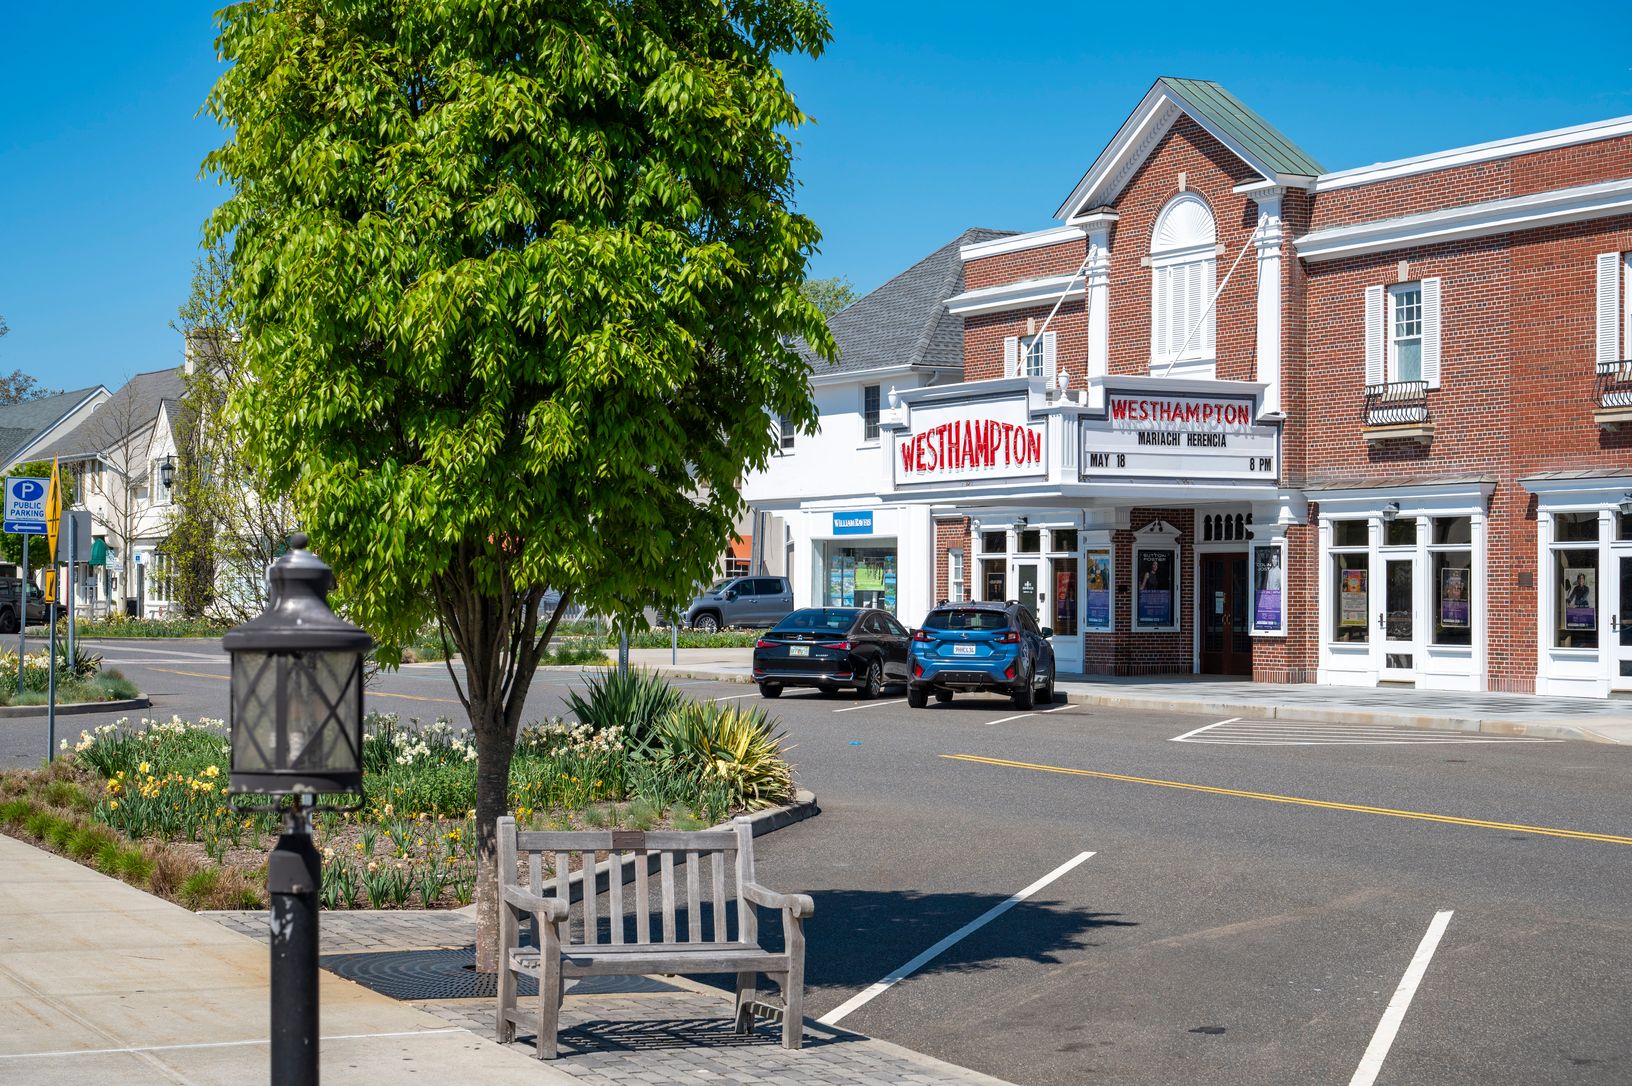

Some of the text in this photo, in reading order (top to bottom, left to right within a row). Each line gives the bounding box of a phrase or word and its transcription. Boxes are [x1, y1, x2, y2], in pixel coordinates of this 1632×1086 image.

[1112, 400, 1249, 425] WESTHAMPTON
[901, 419, 1041, 473] WESTHAMPTON
[1138, 432, 1227, 448] MARIACHI HERENCIA
[1090, 453, 1126, 468] MAY 18
[1249, 457, 1272, 472] 8 PM
[22, 483, 34, 498] P
